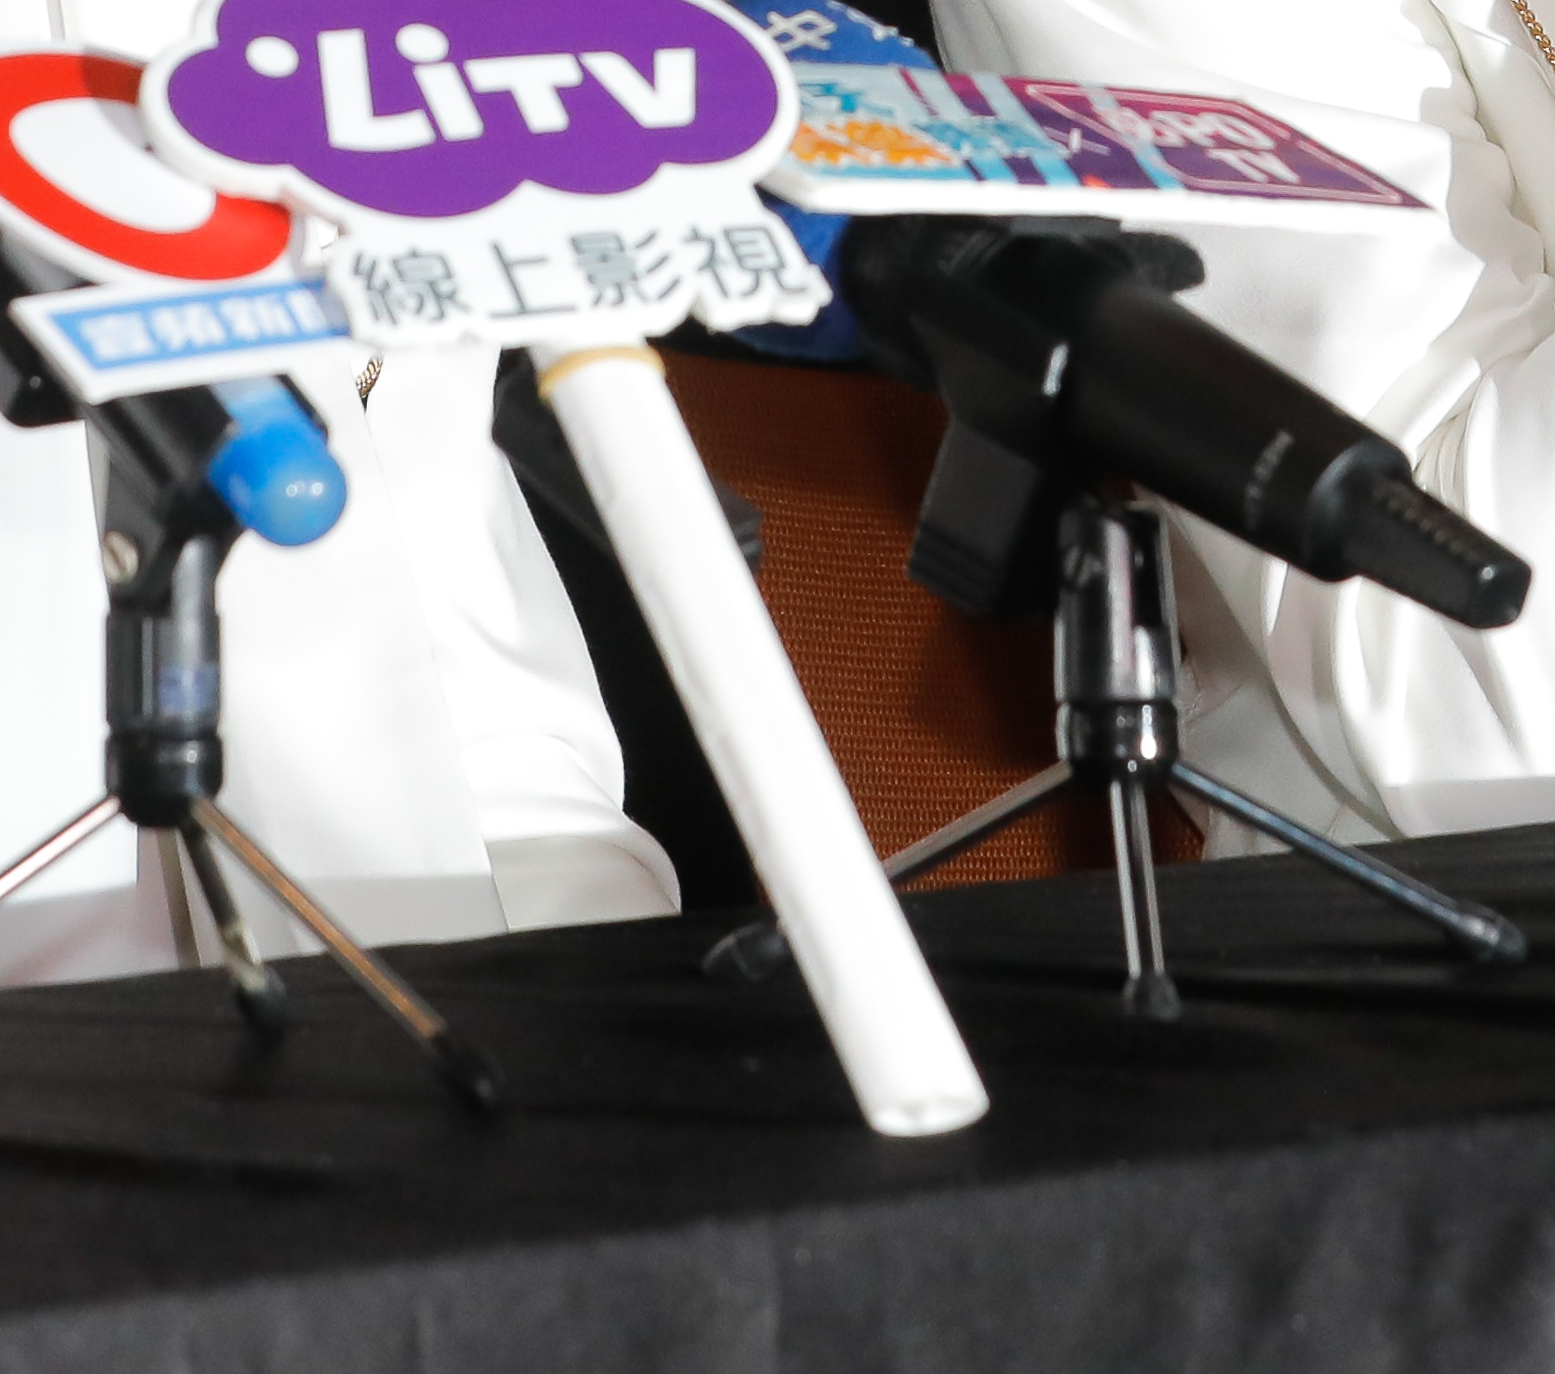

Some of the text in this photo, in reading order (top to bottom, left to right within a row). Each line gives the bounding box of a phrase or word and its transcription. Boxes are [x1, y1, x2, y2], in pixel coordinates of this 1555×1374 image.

[317, 23, 697, 152] LiTV
[351, 224, 812, 327] 線上影視
